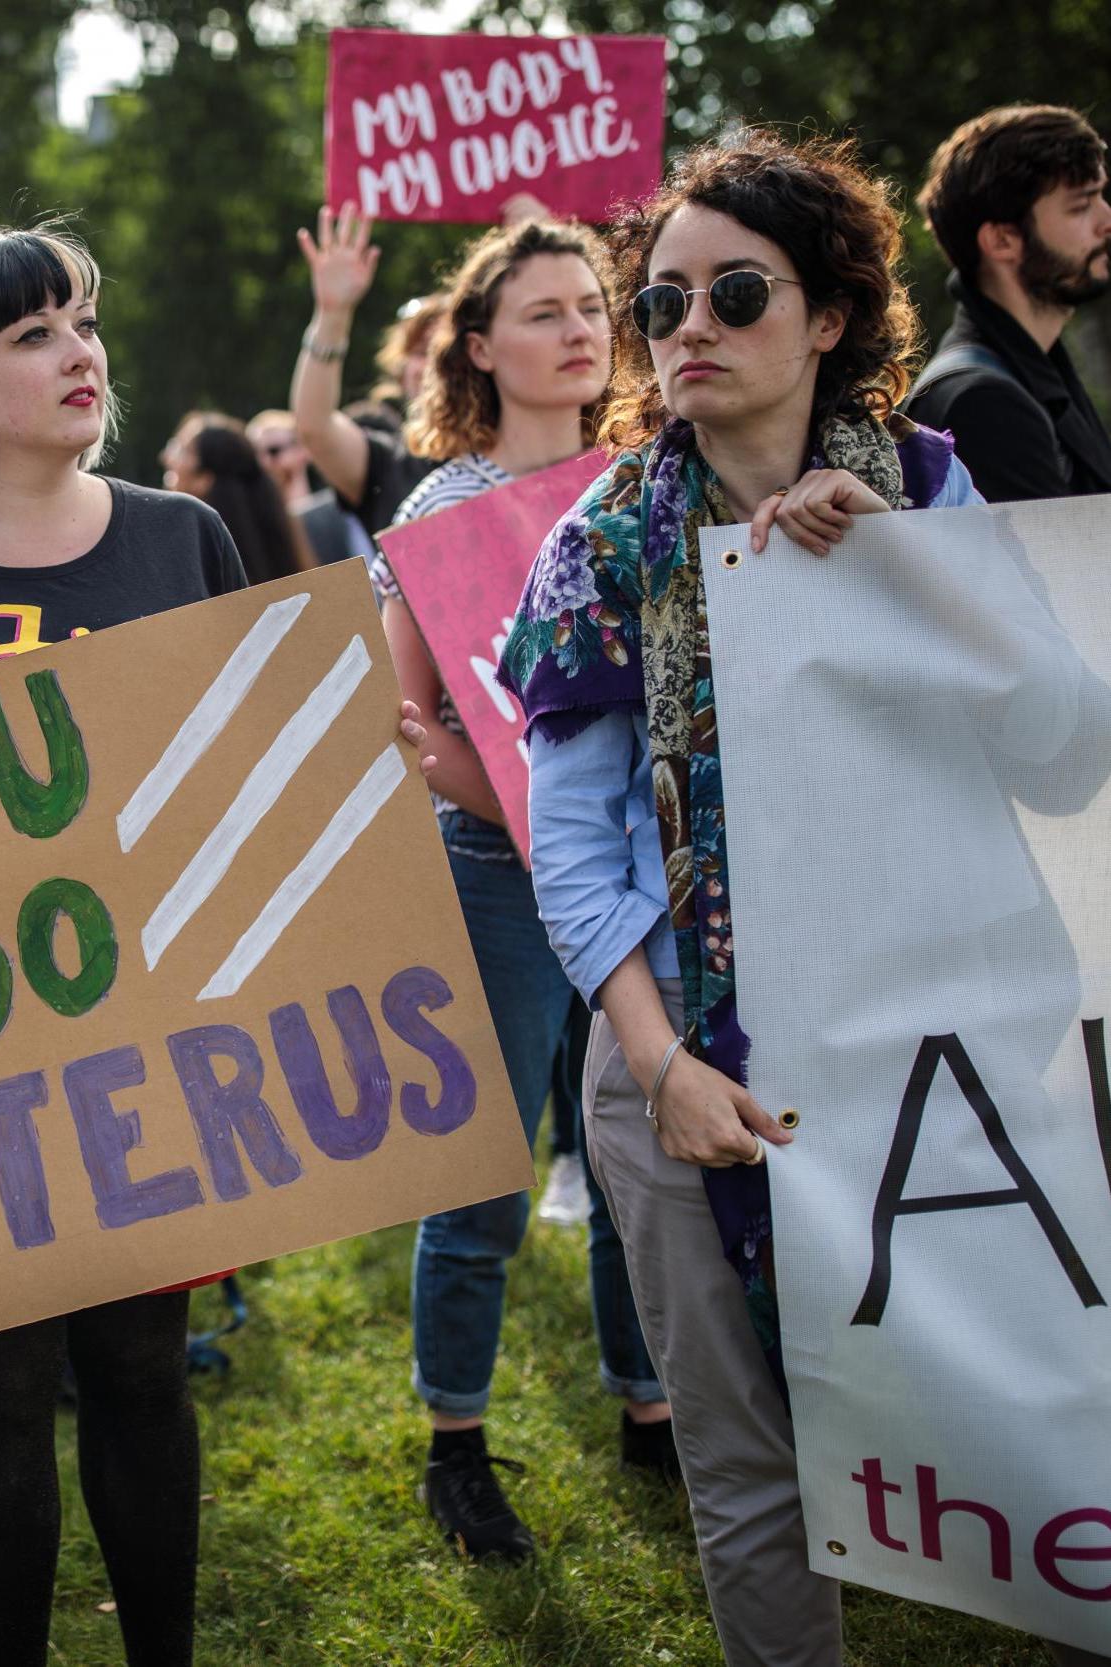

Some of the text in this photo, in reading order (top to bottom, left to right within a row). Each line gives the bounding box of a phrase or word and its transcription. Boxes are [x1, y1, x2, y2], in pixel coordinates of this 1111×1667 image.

[352, 38, 614, 157] MY BODY.
[357, 96, 640, 216] MY CHOICE.
[850, 1457, 1111, 1603] the
